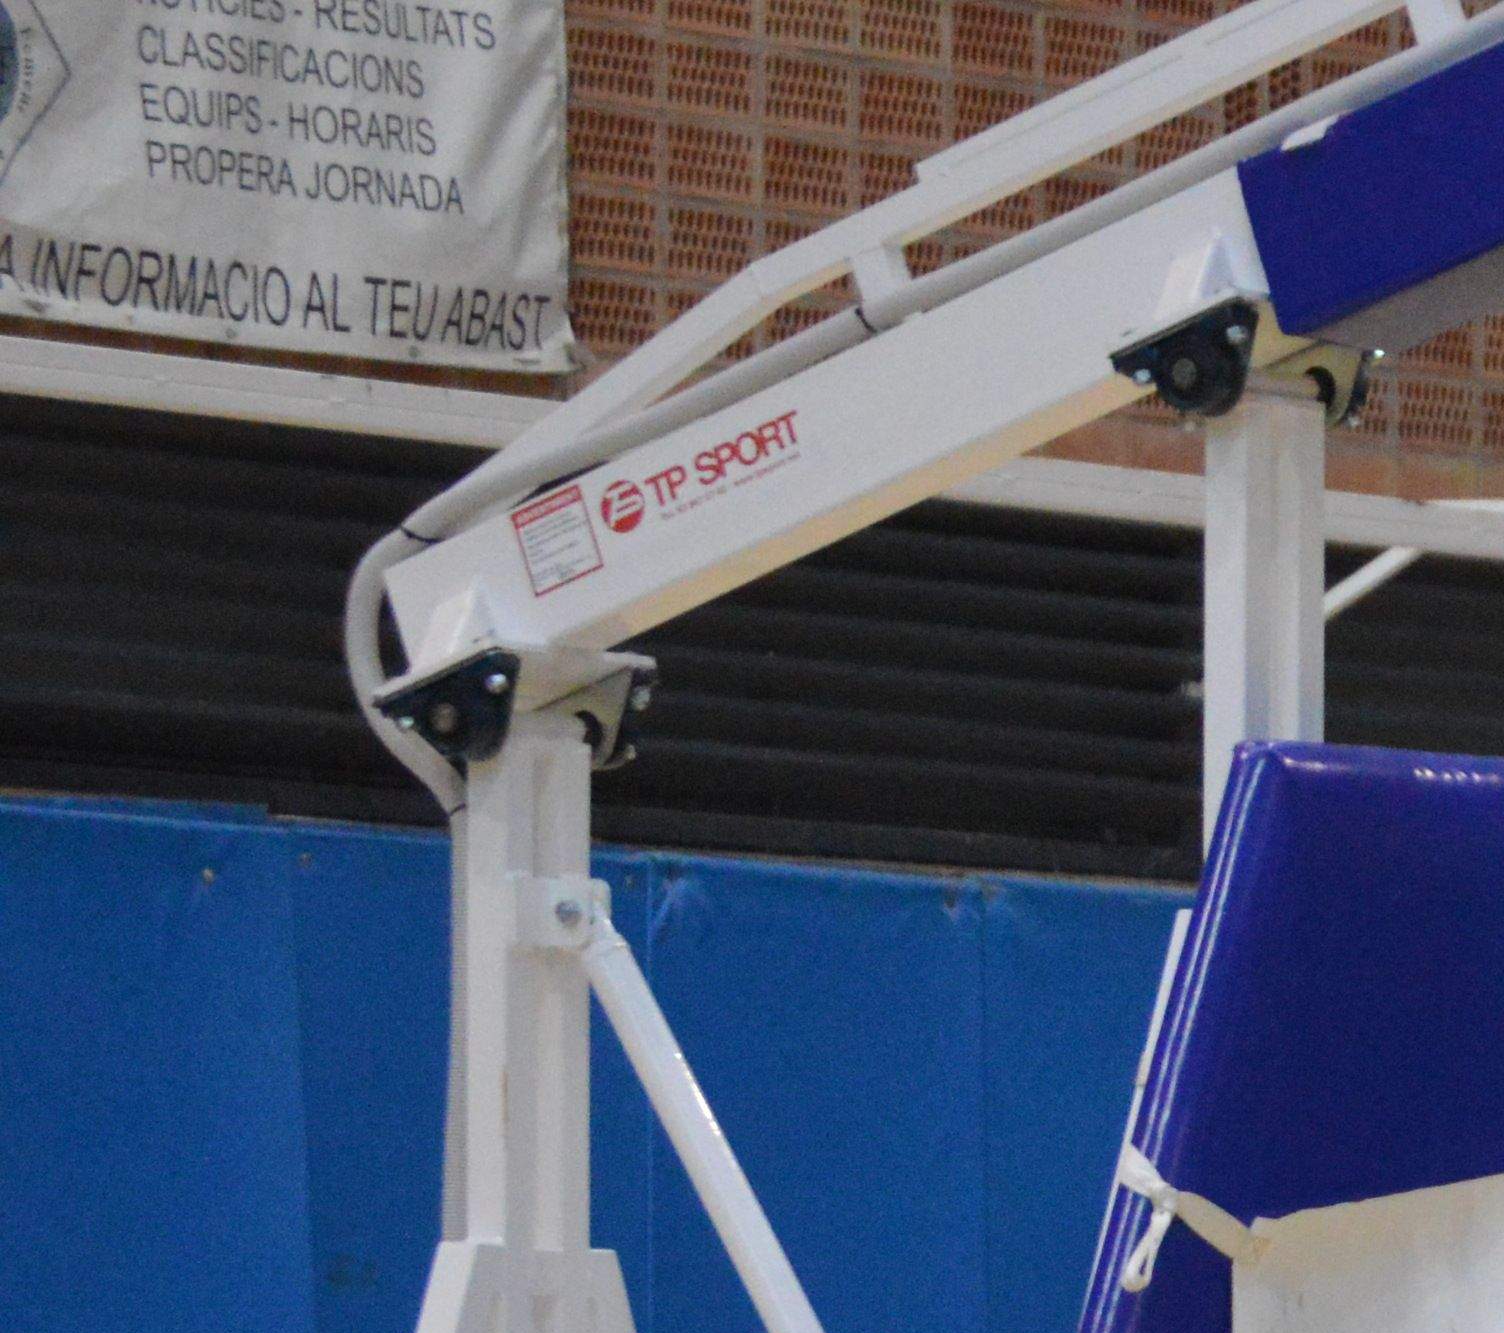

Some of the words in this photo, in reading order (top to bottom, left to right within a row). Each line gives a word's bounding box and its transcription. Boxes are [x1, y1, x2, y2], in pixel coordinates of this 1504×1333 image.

[137, 24, 425, 99] CLASSIFICACIONS
[314, 0, 497, 50] RESULTATS
[139, 82, 264, 134] EQUIPS
[288, 102, 438, 156] HORARIS
[145, 140, 297, 197] PROPERA
[305, 161, 465, 215] JORNADA
[30, 237, 291, 327] INFORMACIO
[302, 270, 351, 333] AL
[363, 275, 439, 342] TEU
[440, 285, 551, 351] ABAST
[644, 464, 688, 508] TP
[694, 409, 799, 486] SPORT
